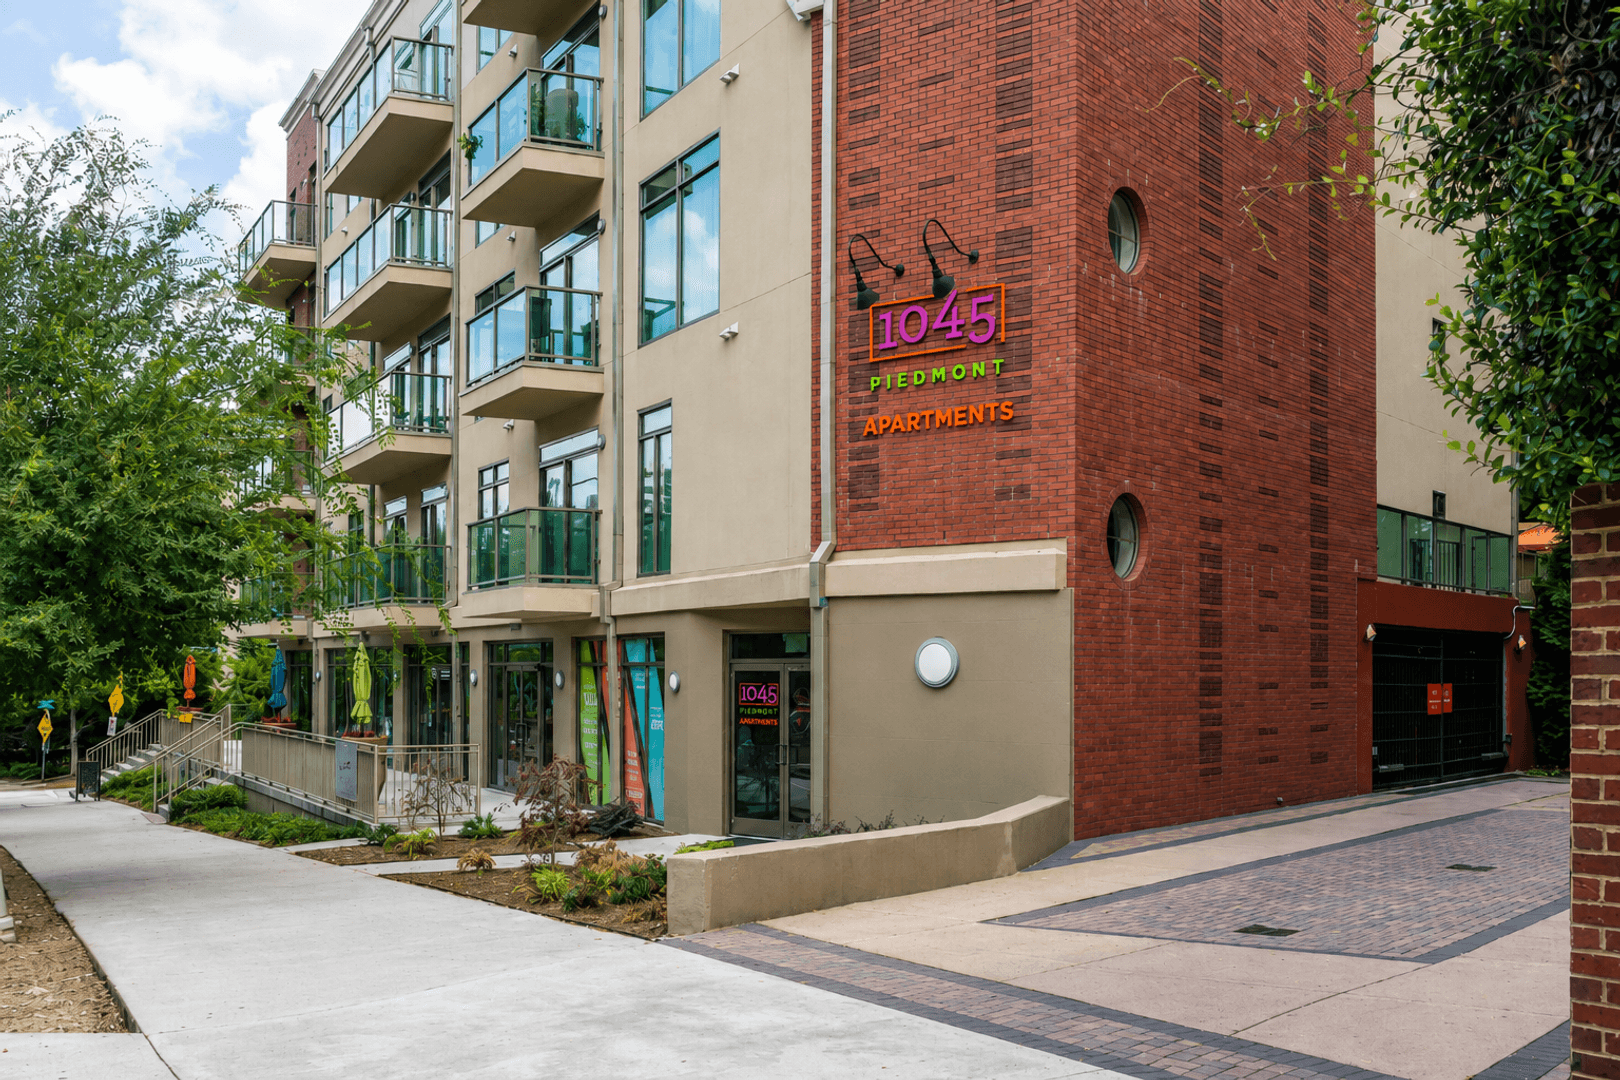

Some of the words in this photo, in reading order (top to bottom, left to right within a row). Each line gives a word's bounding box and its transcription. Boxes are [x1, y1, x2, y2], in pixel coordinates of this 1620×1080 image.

[878, 289, 996, 350] 1045
[870, 358, 1005, 391] PIEDMONT
[862, 401, 1014, 437] APARTMENTS
[741, 684, 778, 704] 1045
